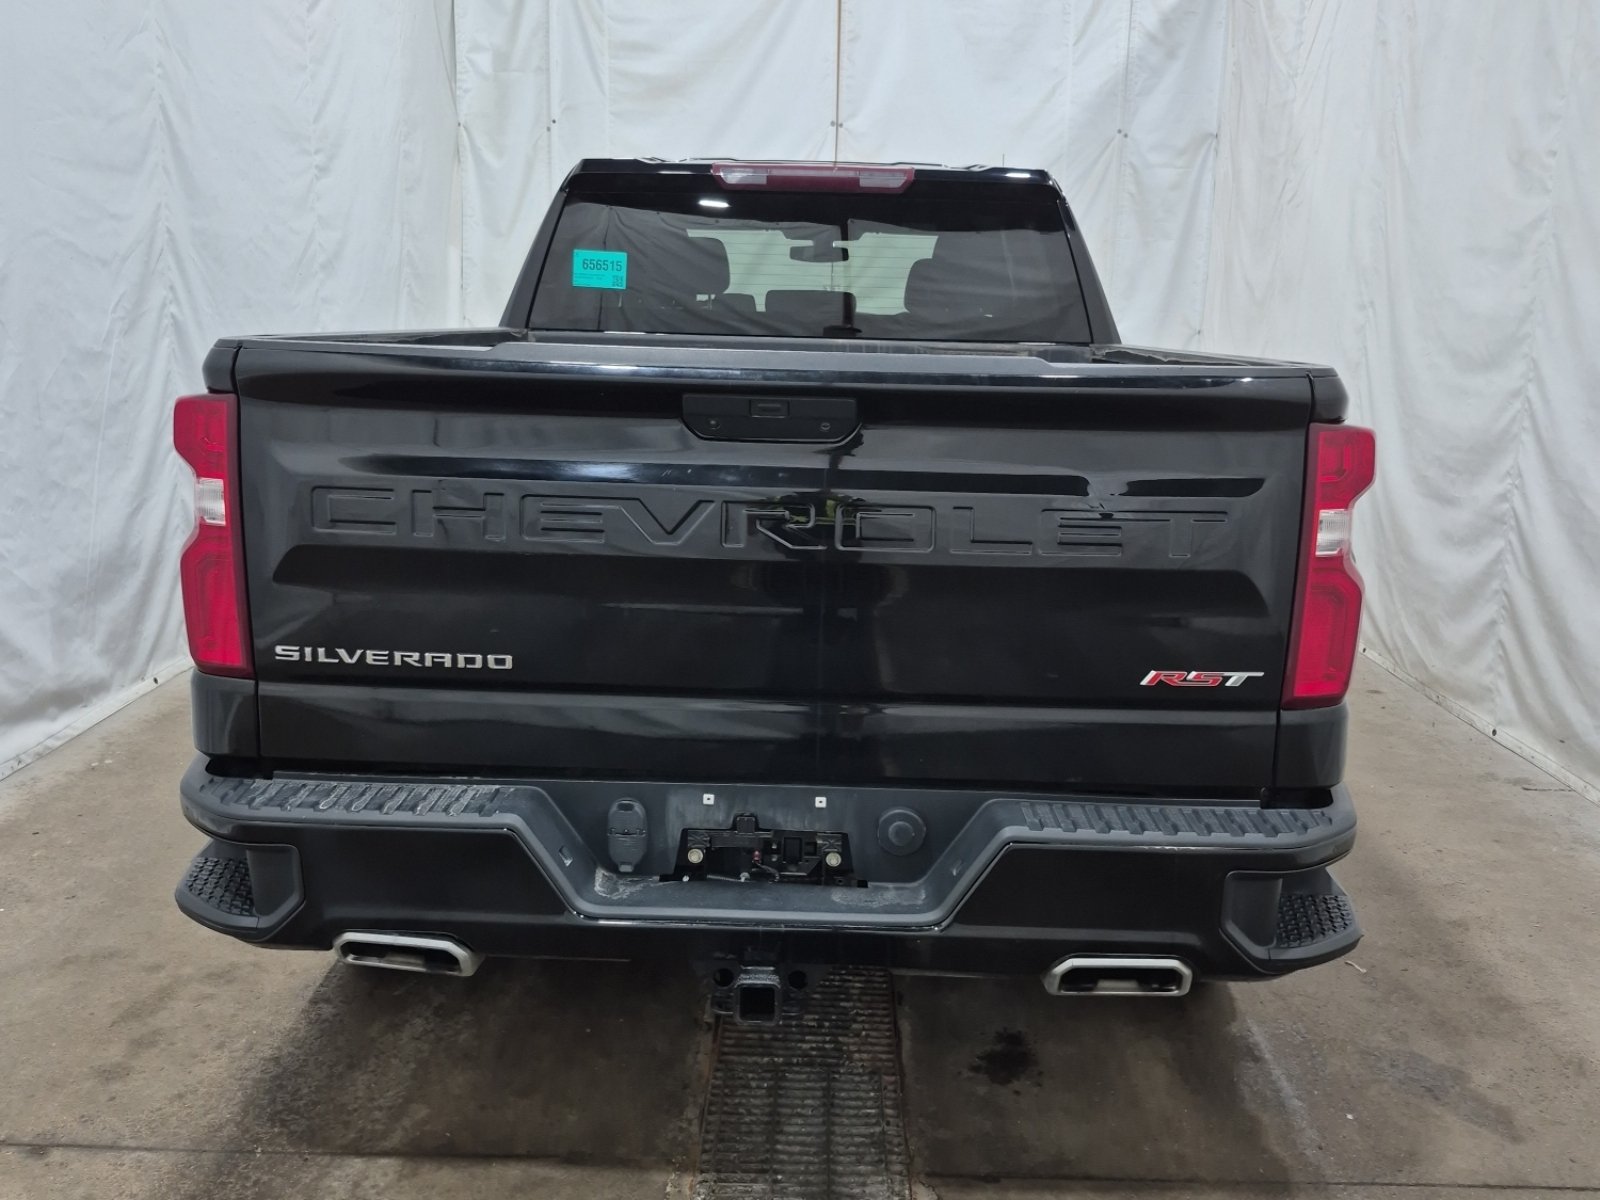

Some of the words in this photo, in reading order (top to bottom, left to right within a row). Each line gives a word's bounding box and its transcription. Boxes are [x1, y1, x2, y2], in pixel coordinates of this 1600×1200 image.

[582, 258, 622, 272] 656515
[310, 485, 1229, 558] CHEVROLET
[274, 645, 513, 670] SILVERADO
[1139, 669, 1265, 687] RST
